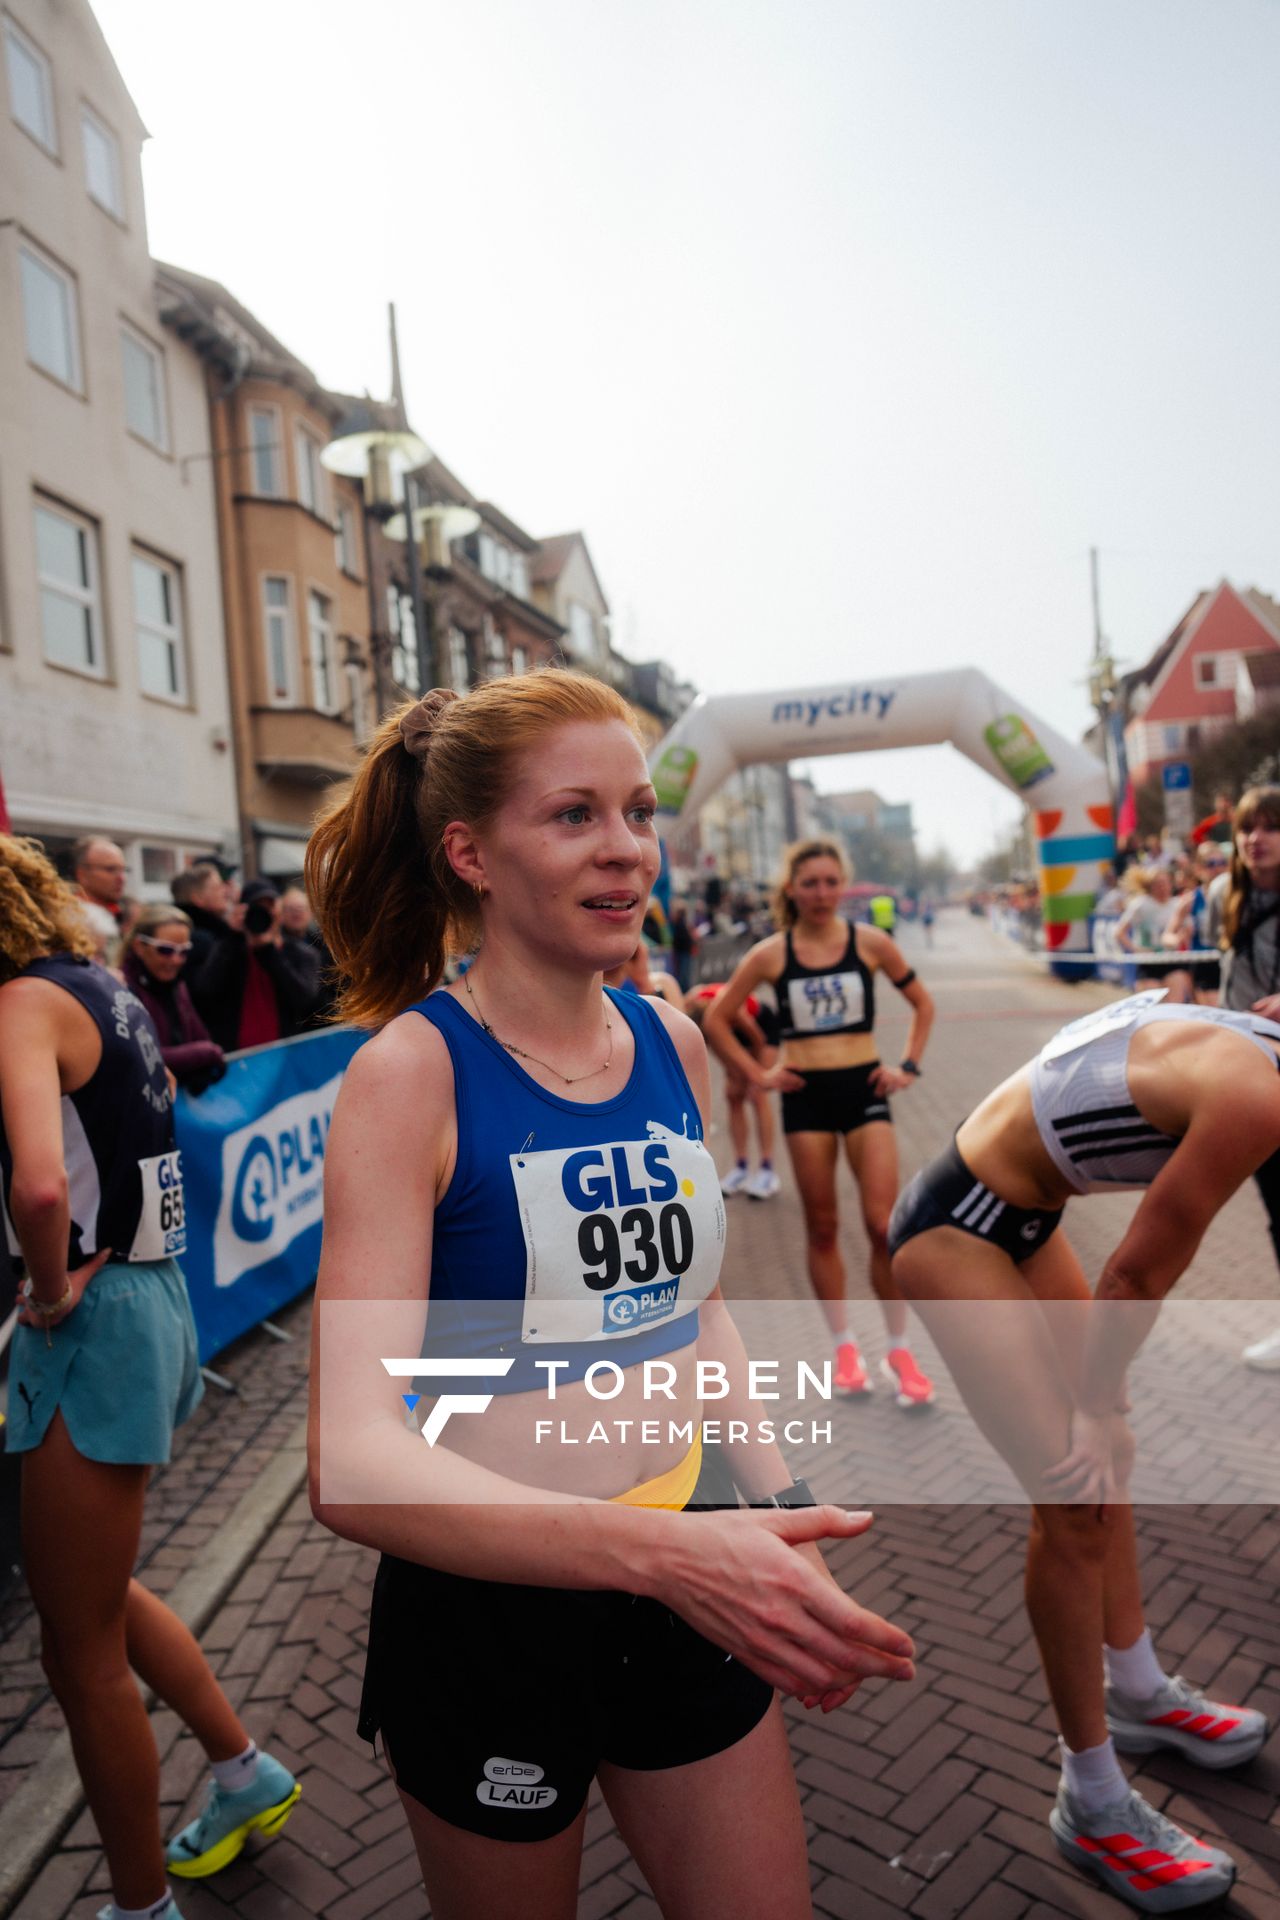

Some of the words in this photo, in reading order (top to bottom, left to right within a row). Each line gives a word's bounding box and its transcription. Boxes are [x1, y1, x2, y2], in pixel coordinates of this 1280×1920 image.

[771, 687, 895, 726] mycity
[577, 1203, 694, 1291] 930
[641, 1285, 677, 1311] PLAN
[492, 1765, 536, 1777] erbe
[488, 1785, 549, 1805] LAUF
